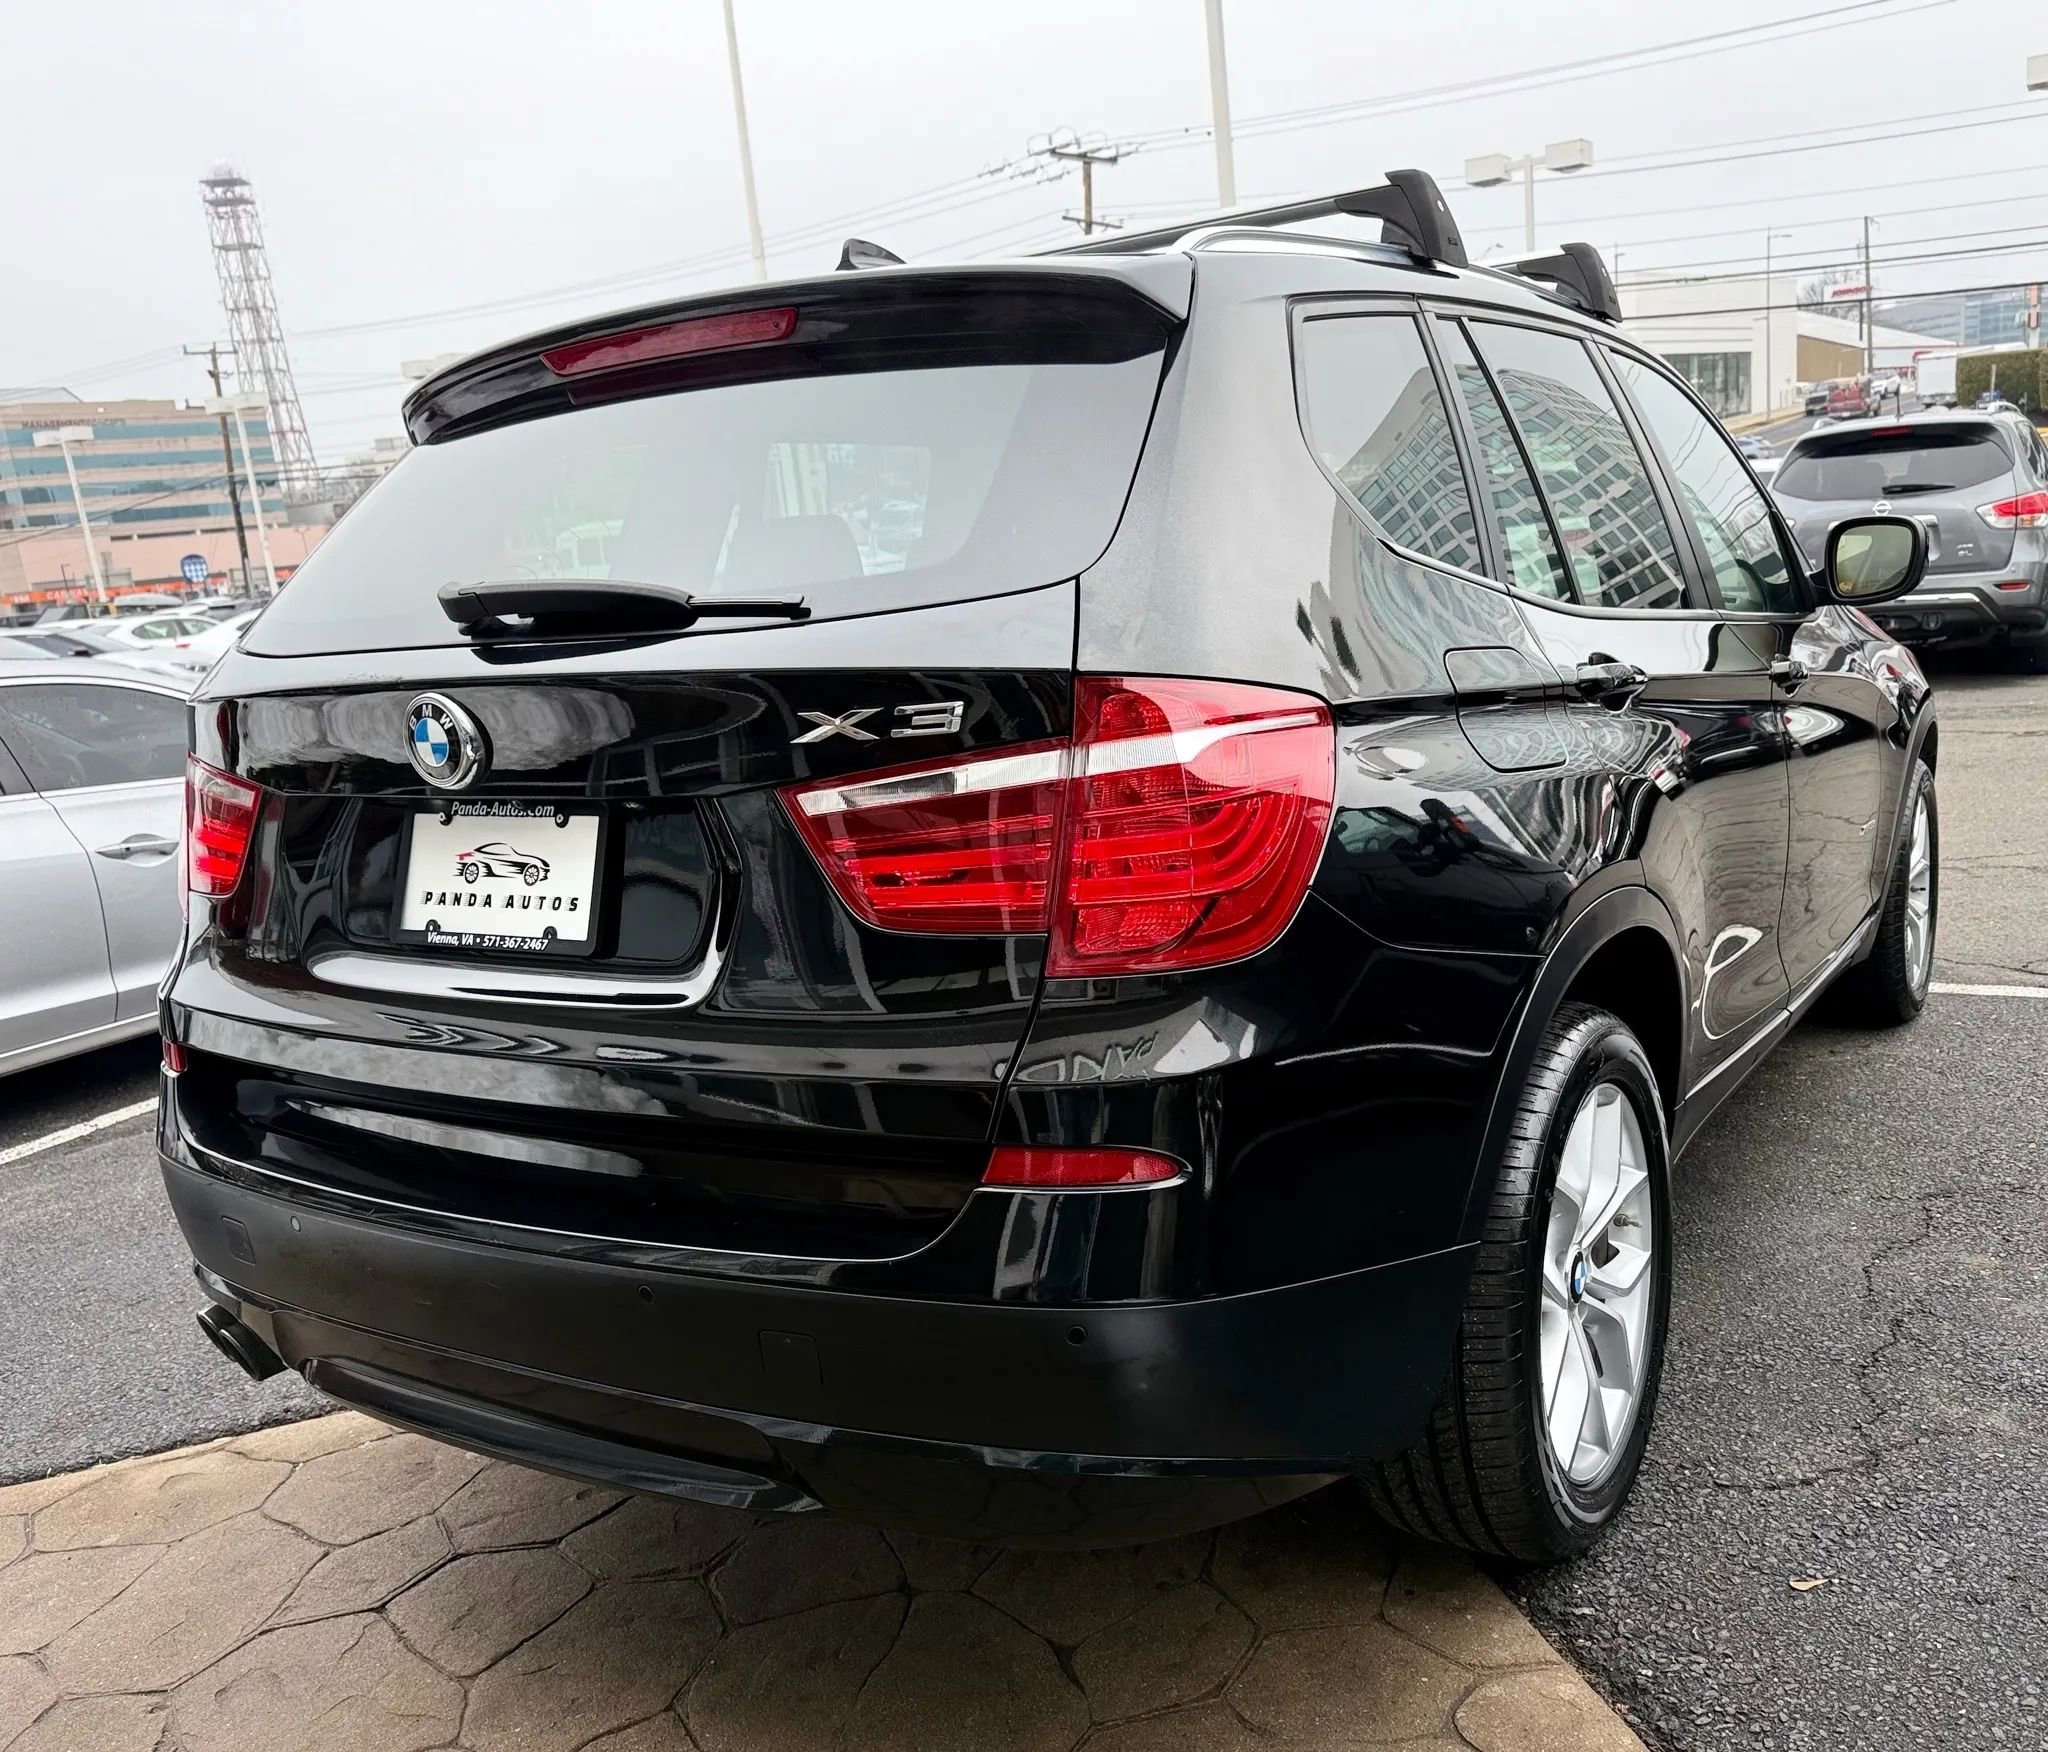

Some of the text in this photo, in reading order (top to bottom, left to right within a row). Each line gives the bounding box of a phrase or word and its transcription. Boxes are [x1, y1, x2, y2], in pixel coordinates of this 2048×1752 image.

[409, 704, 454, 731] BMW
[789, 700, 965, 744] X3
[423, 891, 579, 912] PANDA AUTOS
[427, 931, 549, 950] Vienna, VA 571-367-2467
